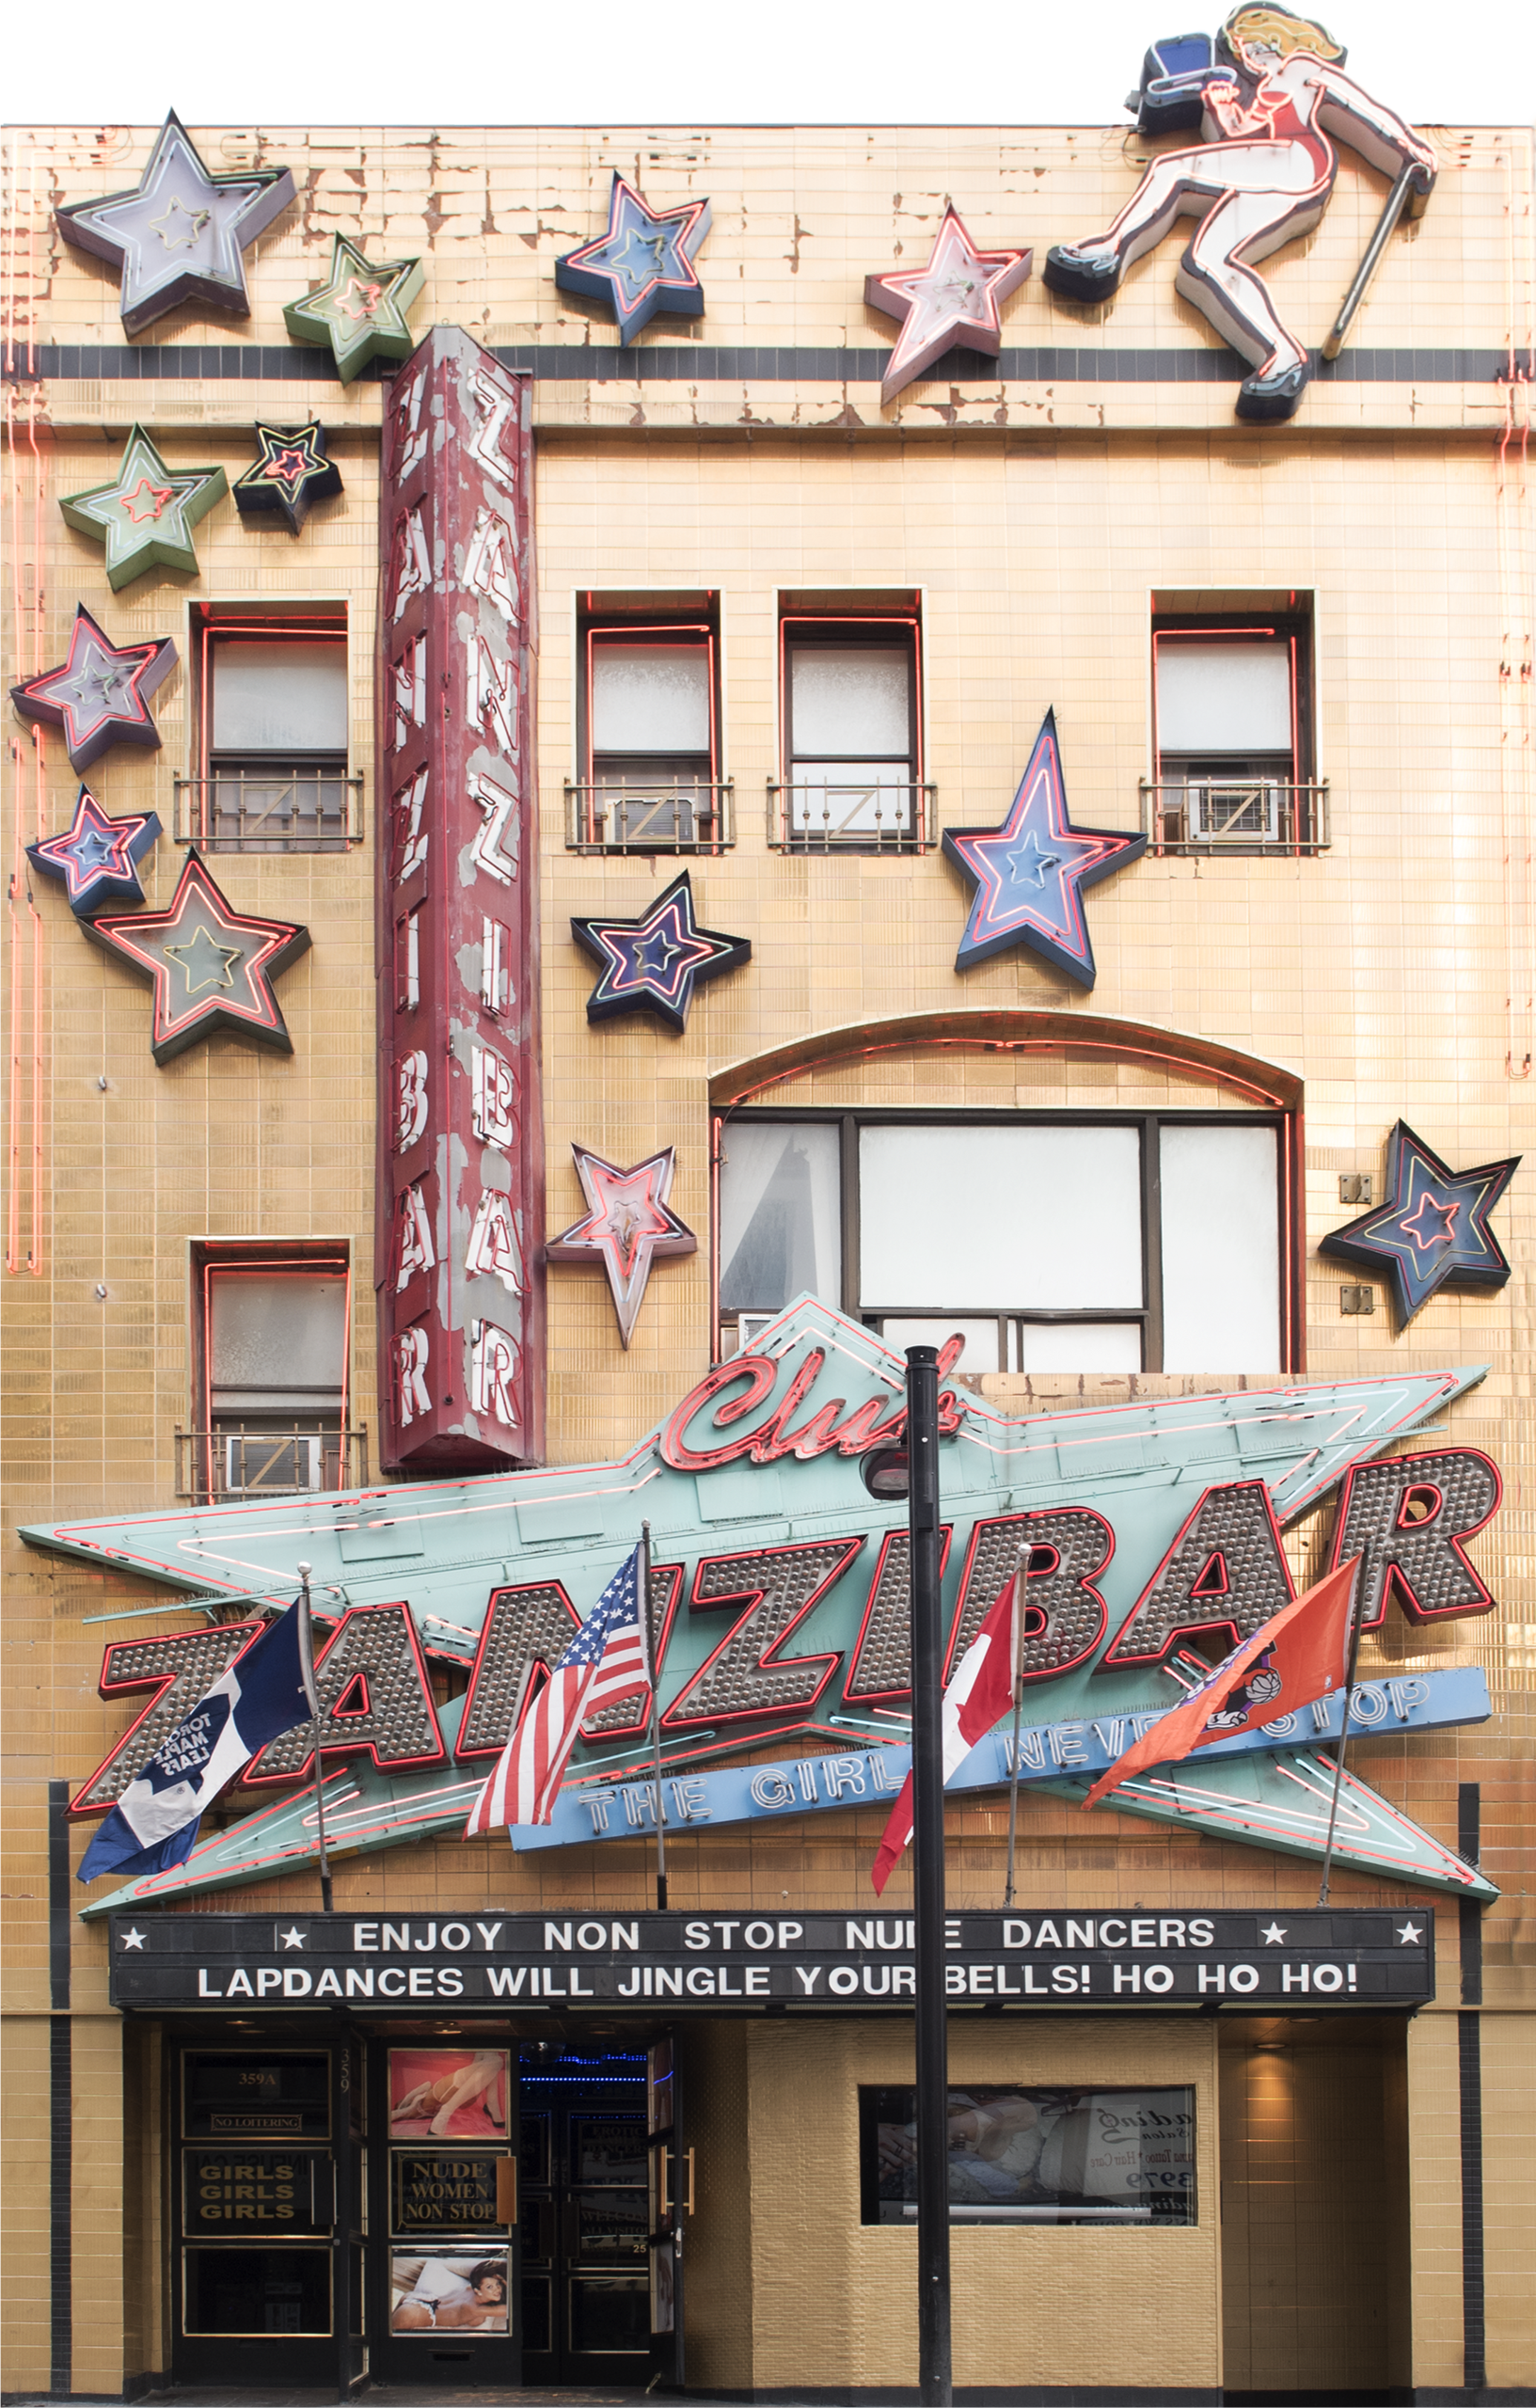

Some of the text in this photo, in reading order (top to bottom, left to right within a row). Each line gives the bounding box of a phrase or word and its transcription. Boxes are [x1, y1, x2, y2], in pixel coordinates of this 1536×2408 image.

[385, 364, 435, 1427] ZANZIBAR
[461, 368, 532, 1429] ZANZIBAR
[66, 1447, 1503, 1823] ZANZIBAR
[578, 1778, 712, 1832] THE
[751, 1753, 907, 1809] GIRL
[1004, 1714, 1167, 1770] NEV
[354, 1919, 1215, 1952] ENJOY NON STOP NUE DANCERS
[198, 1963, 1357, 1997] LAPDANCES WILL JINGLE YOUR BELLS! HO HO HO!
[238, 2072, 277, 2085] 359A
[340, 2048, 350, 2094] 359
[214, 2116, 298, 2128] NO LOITERING
[199, 2164, 294, 2180] GIRLS
[412, 2162, 487, 2178] NUDE
[199, 2184, 294, 2199] GIRLS
[411, 2183, 489, 2199] WOMEN
[199, 2204, 294, 2219] GIRLS
[406, 2204, 495, 2220] NON STOP
[581, 2211, 648, 2222] WELCOM
[607, 2226, 648, 2235] VISITO
[632, 2243, 647, 2254] 25
